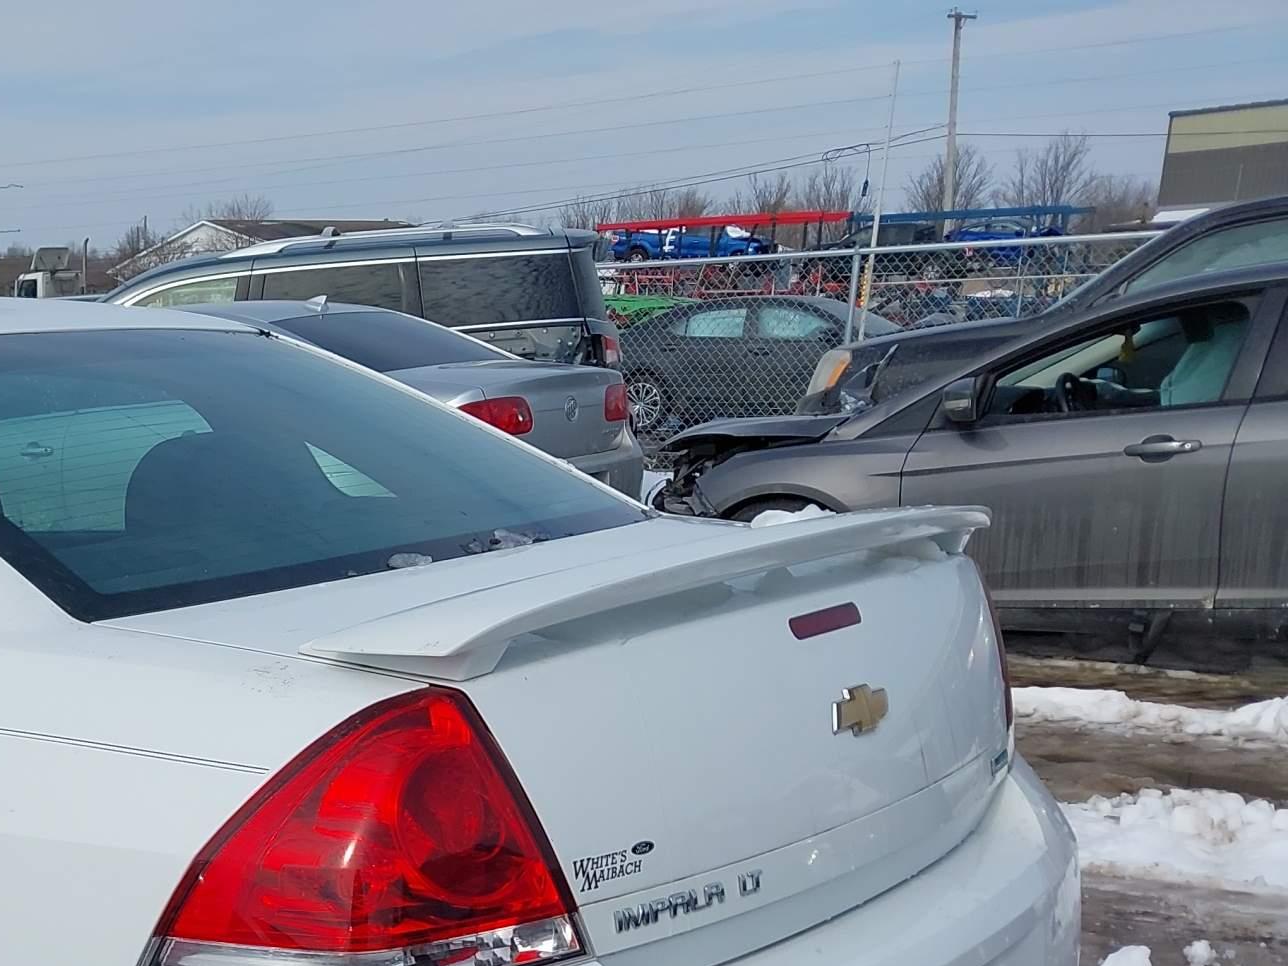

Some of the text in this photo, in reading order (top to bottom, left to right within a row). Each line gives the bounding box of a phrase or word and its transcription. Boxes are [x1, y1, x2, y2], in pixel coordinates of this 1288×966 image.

[579, 859, 643, 892] MAIBACH
[613, 869, 763, 934] IMPALA LT
